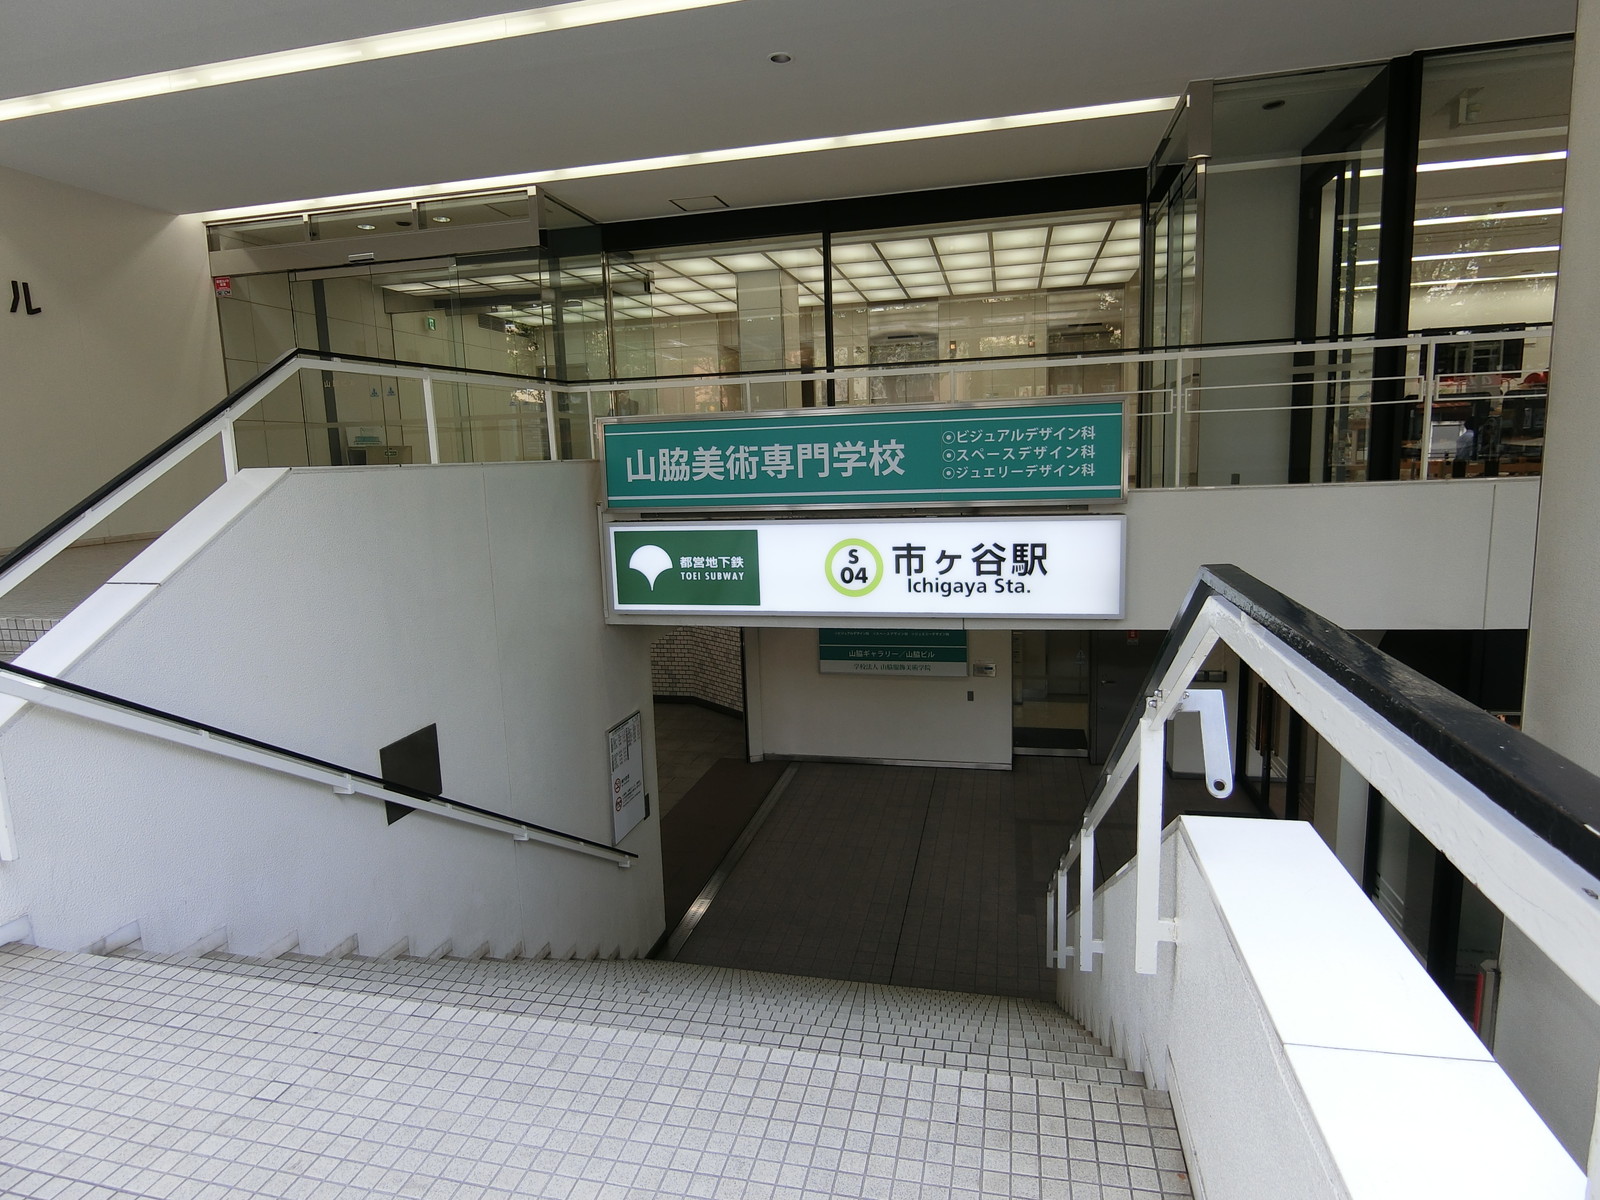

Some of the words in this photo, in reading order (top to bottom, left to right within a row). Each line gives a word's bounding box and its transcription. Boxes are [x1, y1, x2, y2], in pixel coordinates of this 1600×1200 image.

[10, 280, 42, 315] ル
[956, 425, 1096, 443] ビジュアルデザイン科
[626, 439, 905, 482] 山脇美術専門学校
[956, 444, 1096, 462] スペースデザイン科
[956, 463, 1096, 479] ジュエリーデザイン科
[680, 556, 744, 569] 都営地下鉄
[848, 549, 859, 564] S
[680, 571, 701, 580] TOEI
[704, 571, 744, 580] SUBWAY
[840, 567, 868, 584] 04
[907, 577, 987, 597] Ichigaya
[994, 578, 1031, 593] Sta.
